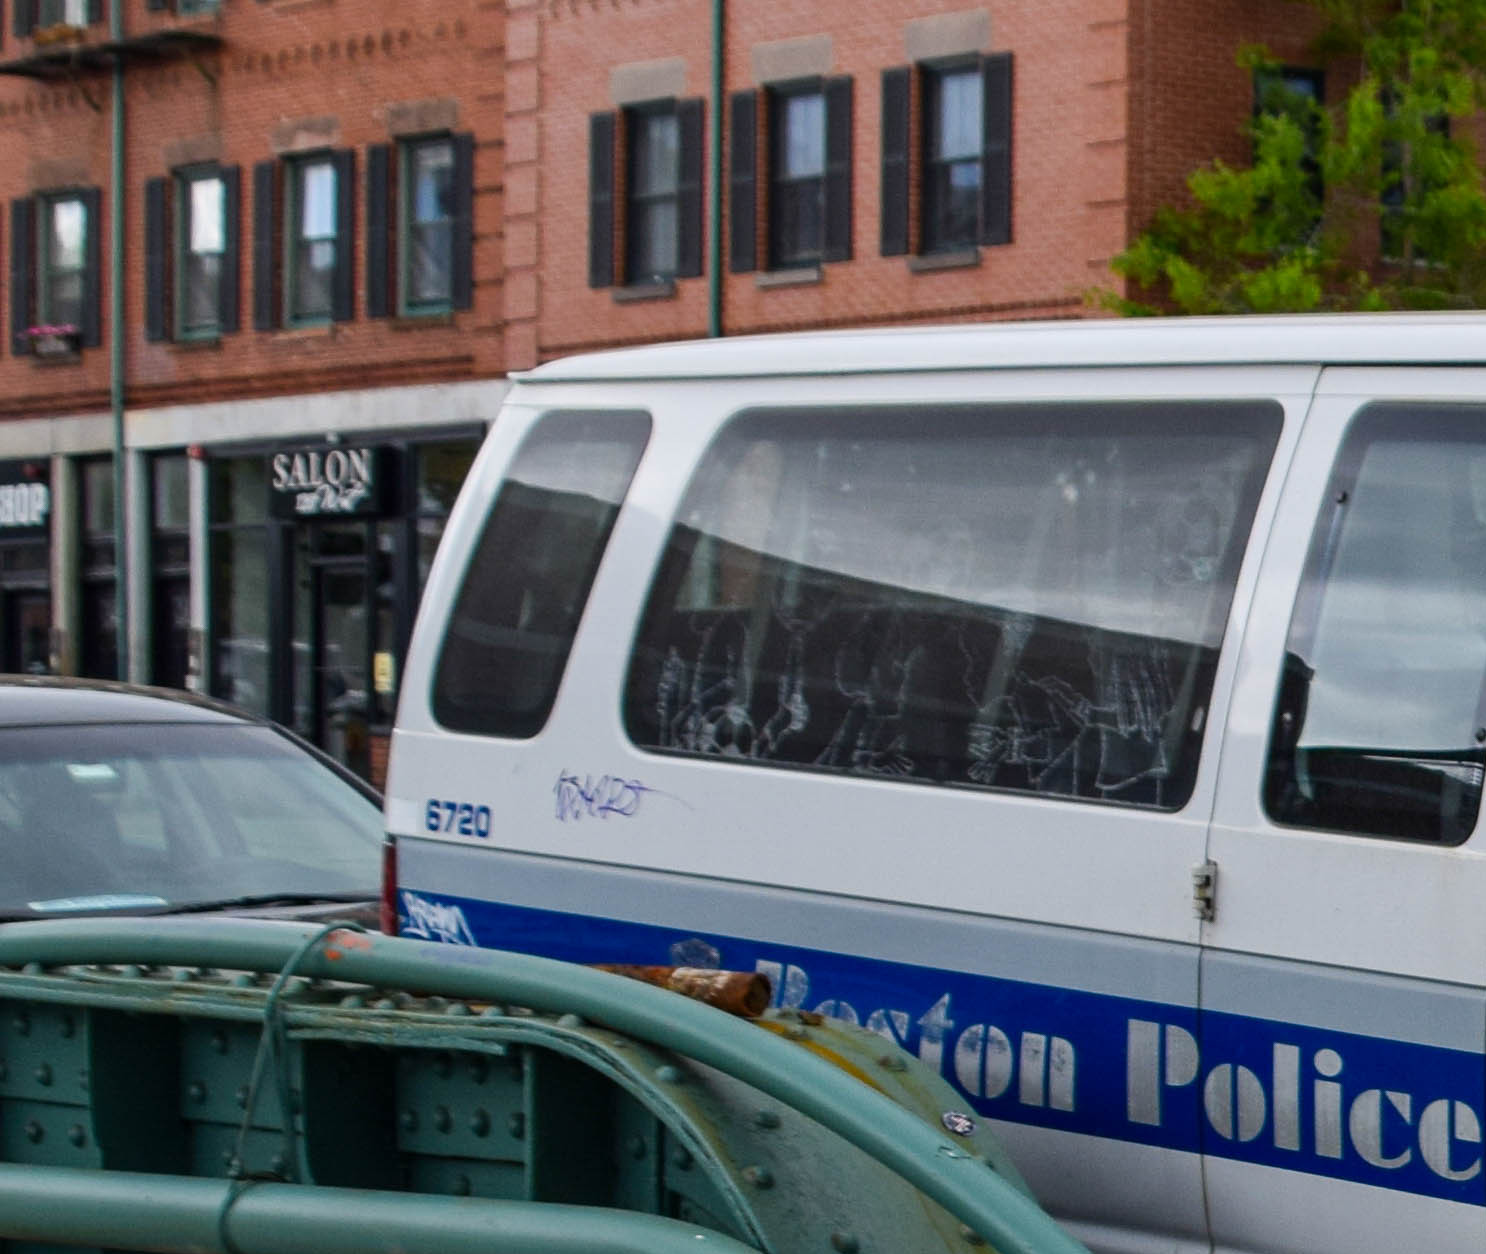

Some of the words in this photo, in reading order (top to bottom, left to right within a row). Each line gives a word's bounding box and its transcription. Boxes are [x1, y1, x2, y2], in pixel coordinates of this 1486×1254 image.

[272, 449, 371, 489] SALON
[0, 483, 48, 525] HOP
[425, 799, 490, 838] 6720
[1127, 1019, 1481, 1181] Police
